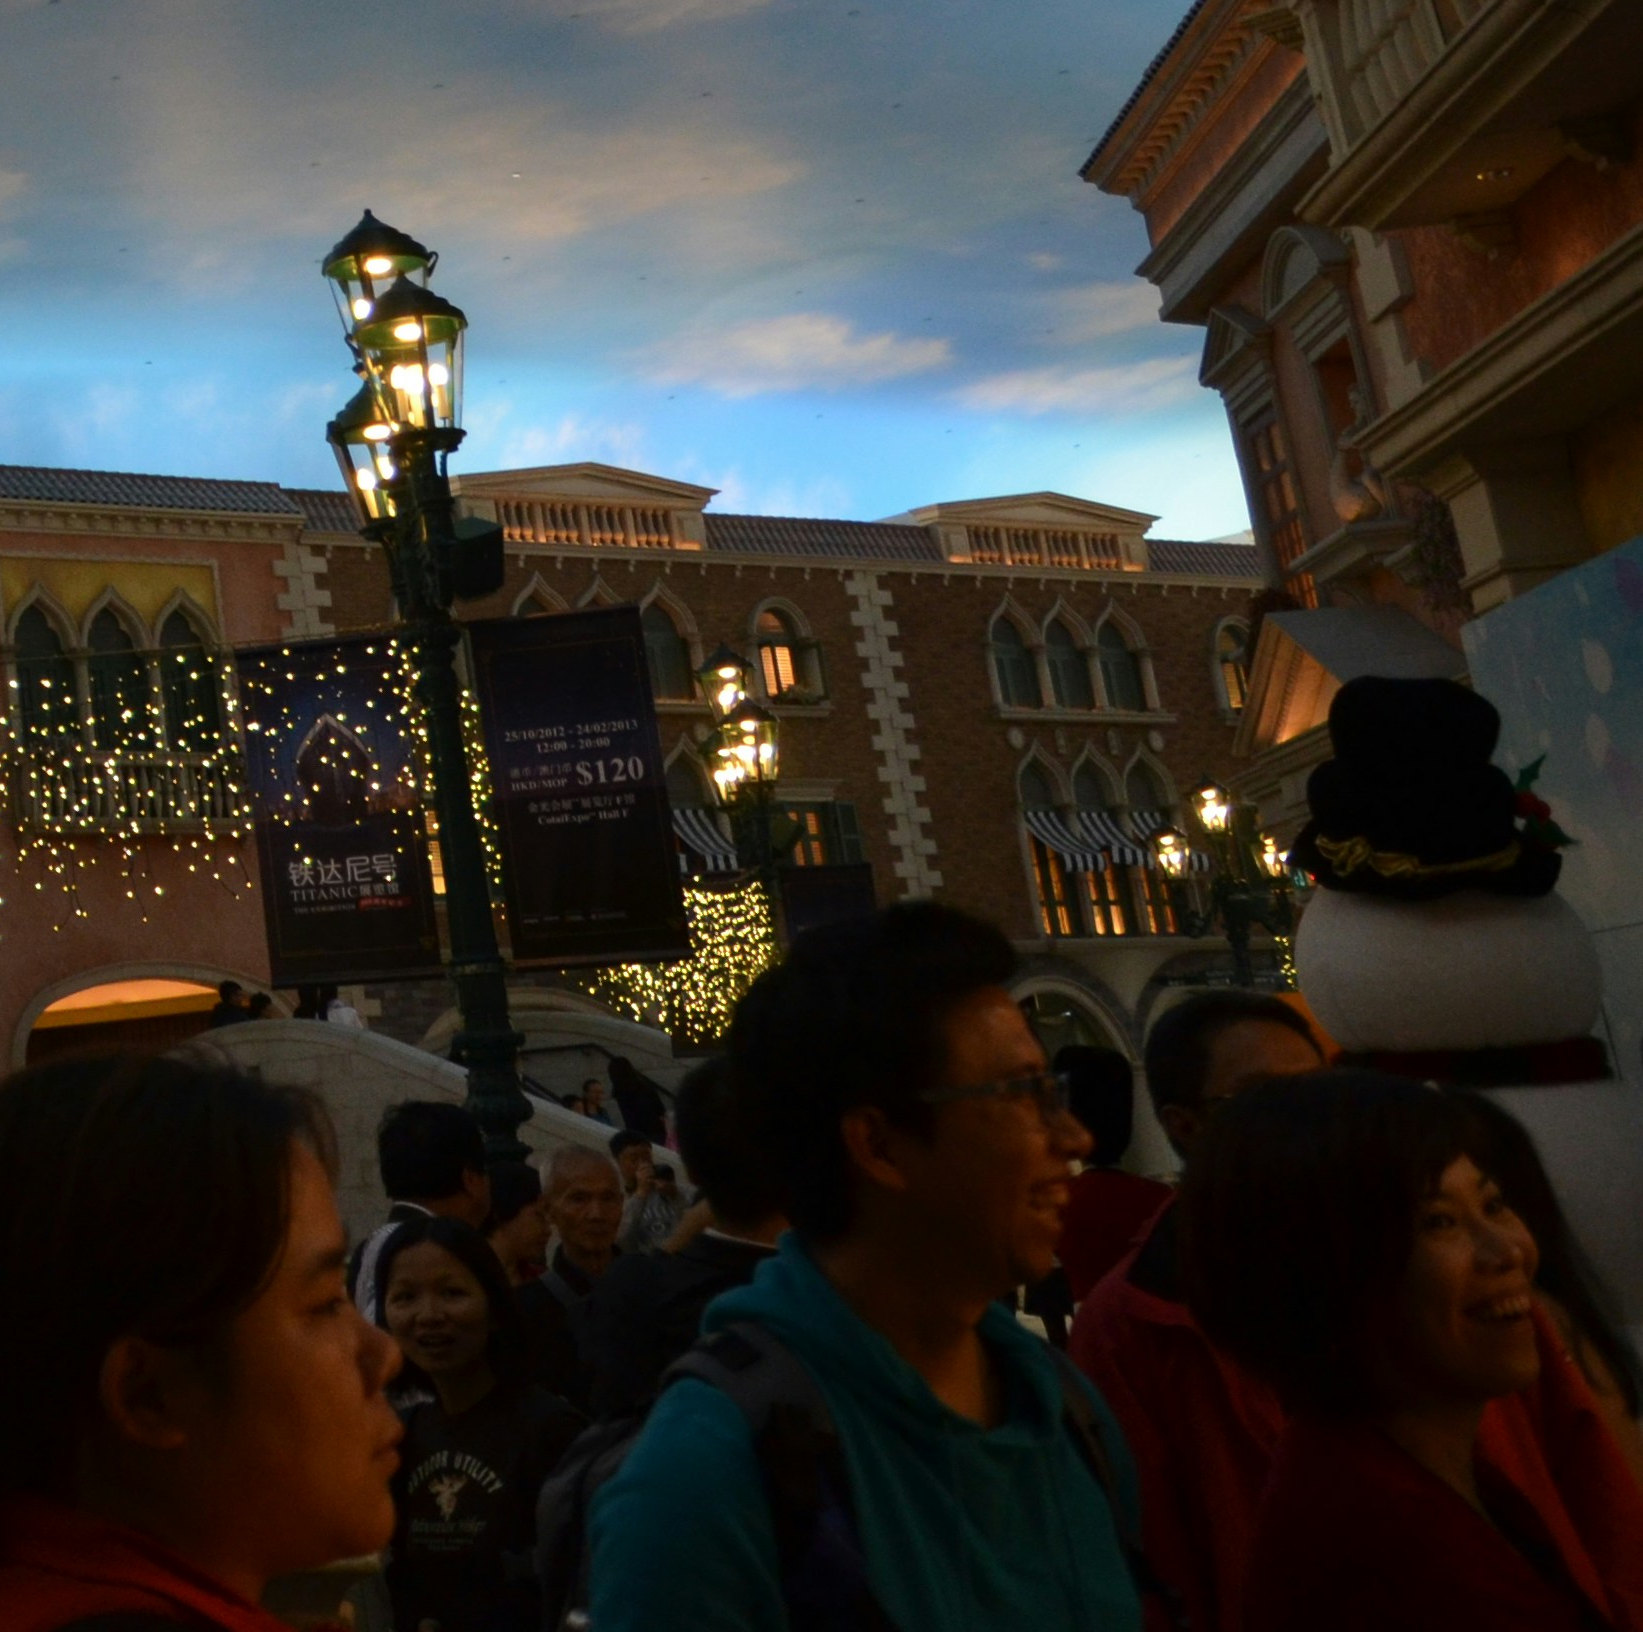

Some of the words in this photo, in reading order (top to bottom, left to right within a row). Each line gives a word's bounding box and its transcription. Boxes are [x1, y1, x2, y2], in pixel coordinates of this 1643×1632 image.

[511, 778, 568, 792] HKD/MOP
[575, 756, 645, 786] $120
[288, 854, 397, 887] 铁达尼号
[291, 886, 358, 902] TITANIC
[453, 1450, 505, 1495] UTILITY
